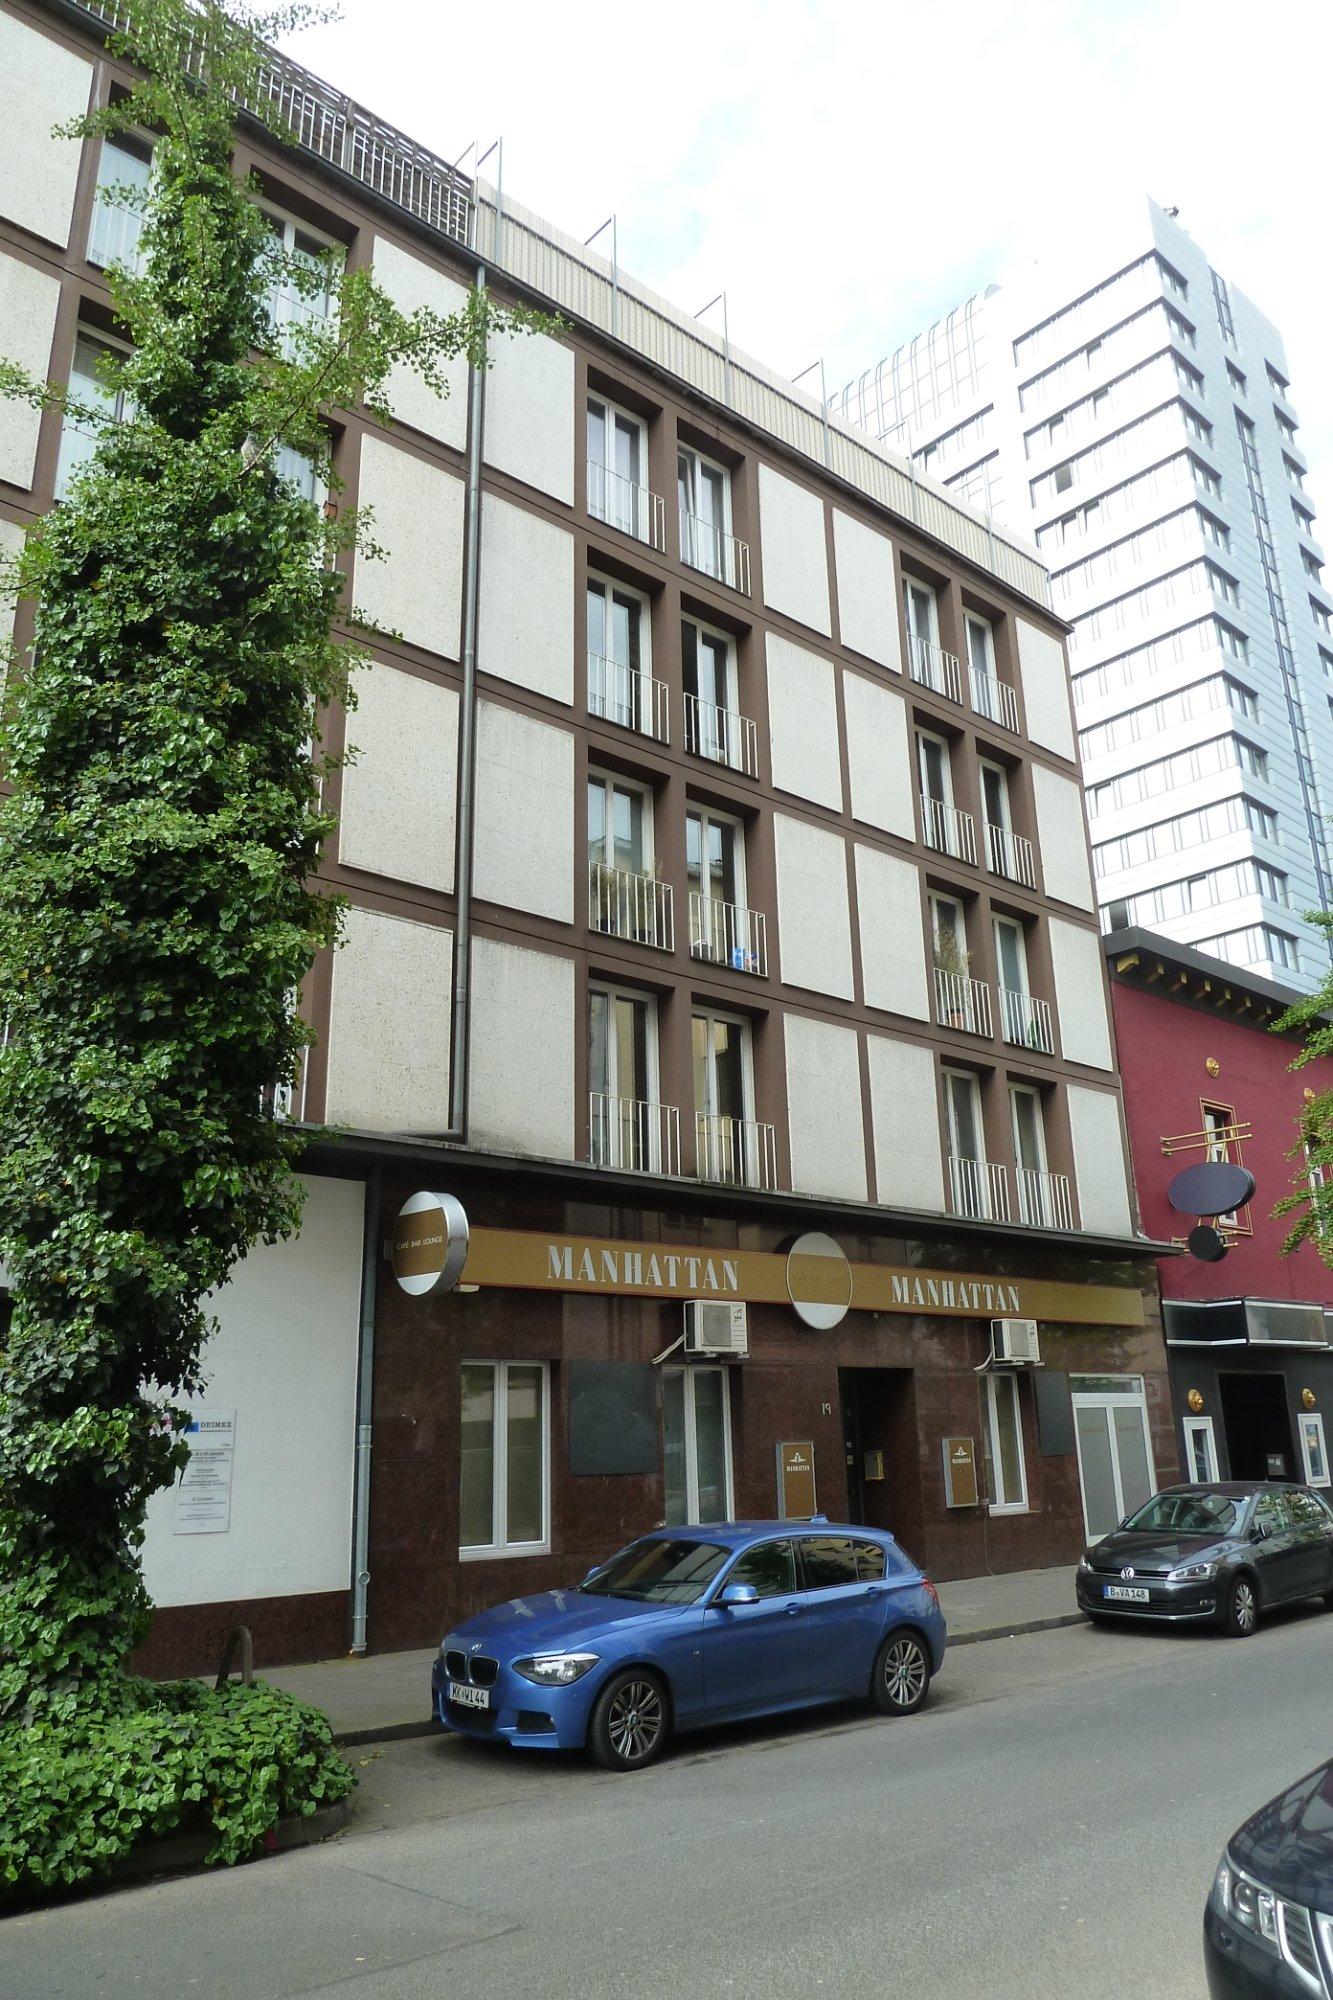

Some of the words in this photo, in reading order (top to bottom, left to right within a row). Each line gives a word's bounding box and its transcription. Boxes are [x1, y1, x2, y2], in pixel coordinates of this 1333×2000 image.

[422, 1235, 443, 1245] LOUNGE
[546, 1245, 740, 1291] MANHATTAN
[890, 1275, 1021, 1312] MANHATTAN
[820, 1402, 833, 1416] 19
